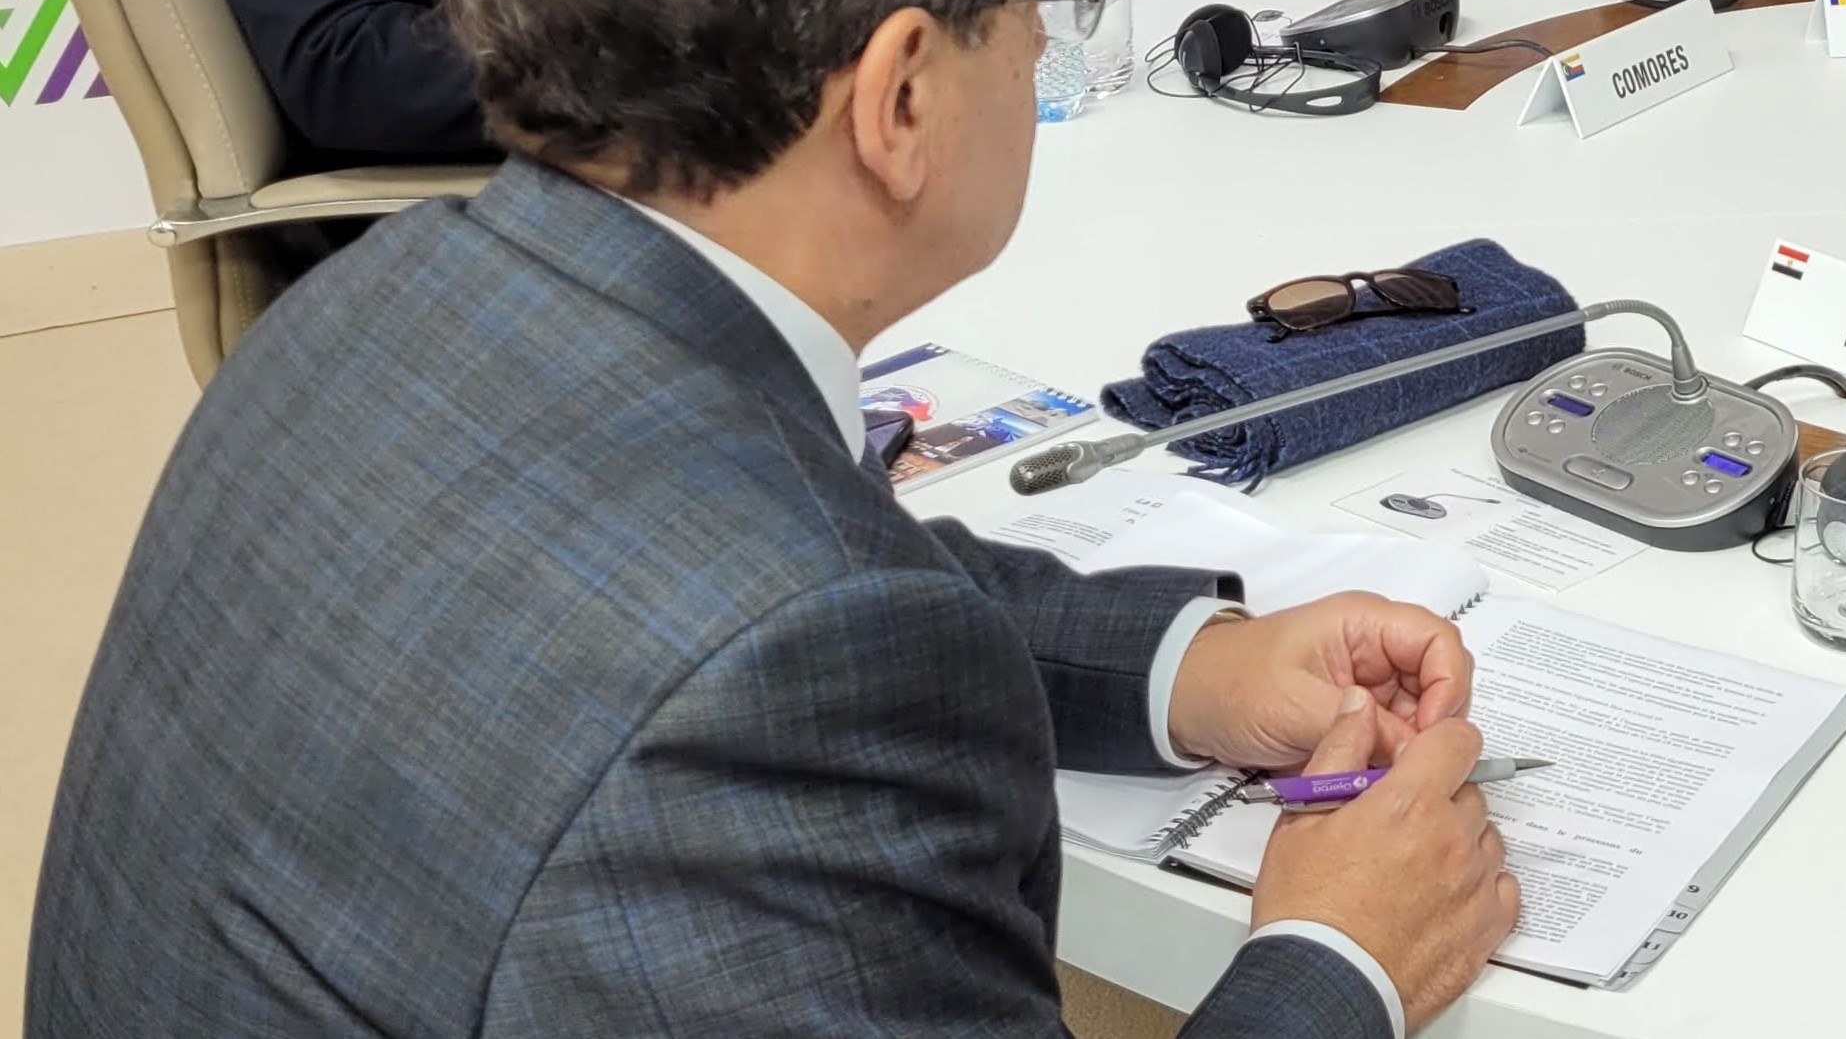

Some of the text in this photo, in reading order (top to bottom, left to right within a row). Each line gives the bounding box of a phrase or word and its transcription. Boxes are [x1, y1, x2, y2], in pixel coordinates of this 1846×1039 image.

[1611, 44, 1690, 100] COMORES
[1623, 367, 1652, 380] BOSCH
[1687, 884, 1700, 893] 9
[1667, 910, 1688, 920] 10
